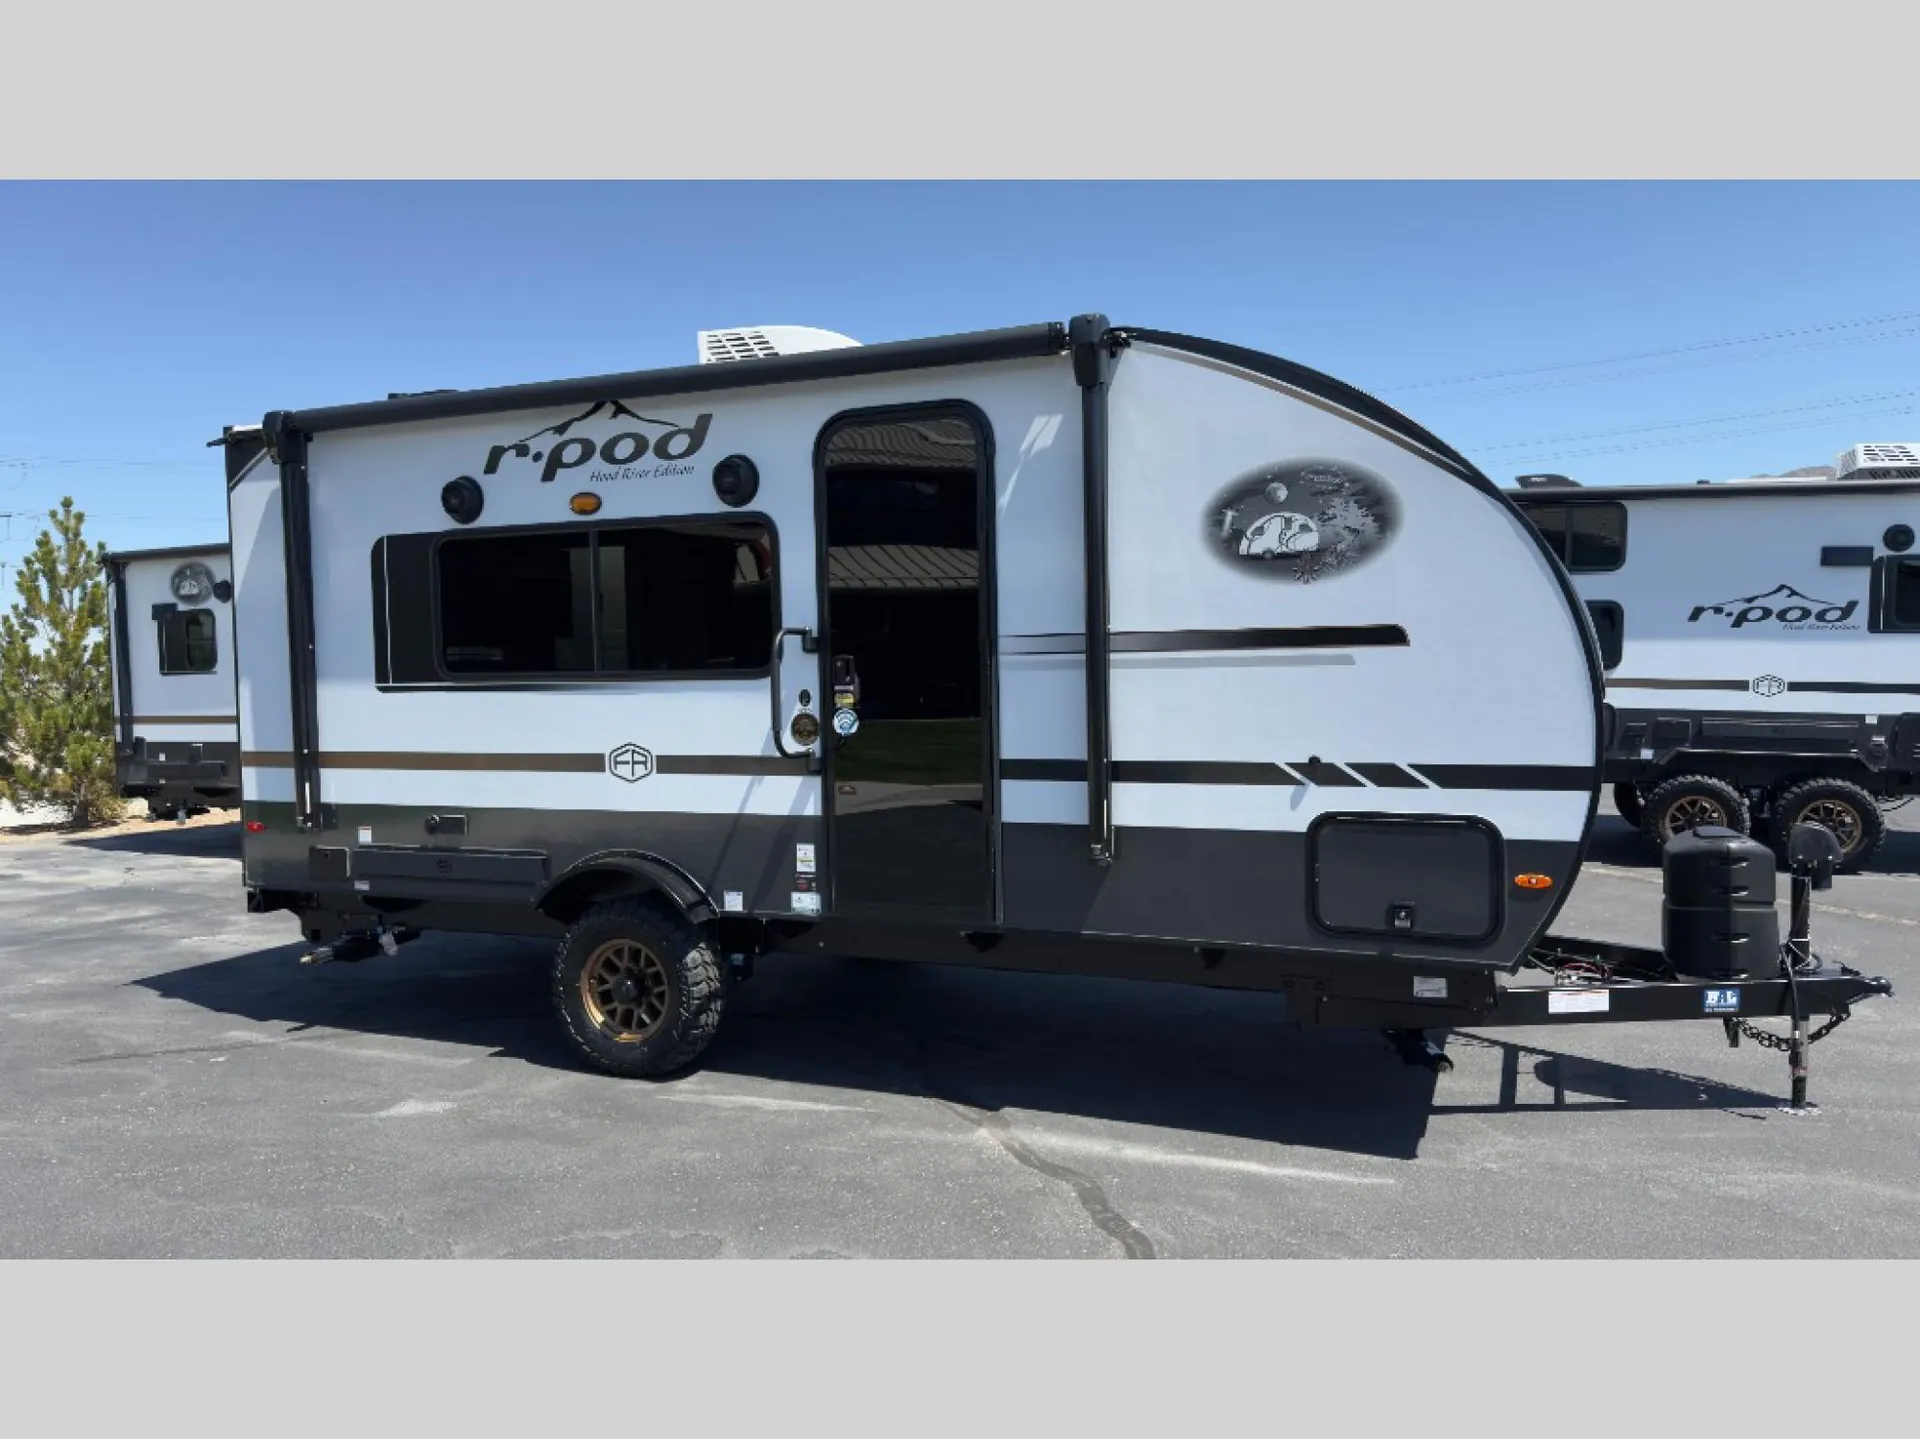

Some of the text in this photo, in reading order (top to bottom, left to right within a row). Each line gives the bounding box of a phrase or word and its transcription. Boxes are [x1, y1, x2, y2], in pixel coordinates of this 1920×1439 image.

[590, 463, 695, 482] Hood River Edition
